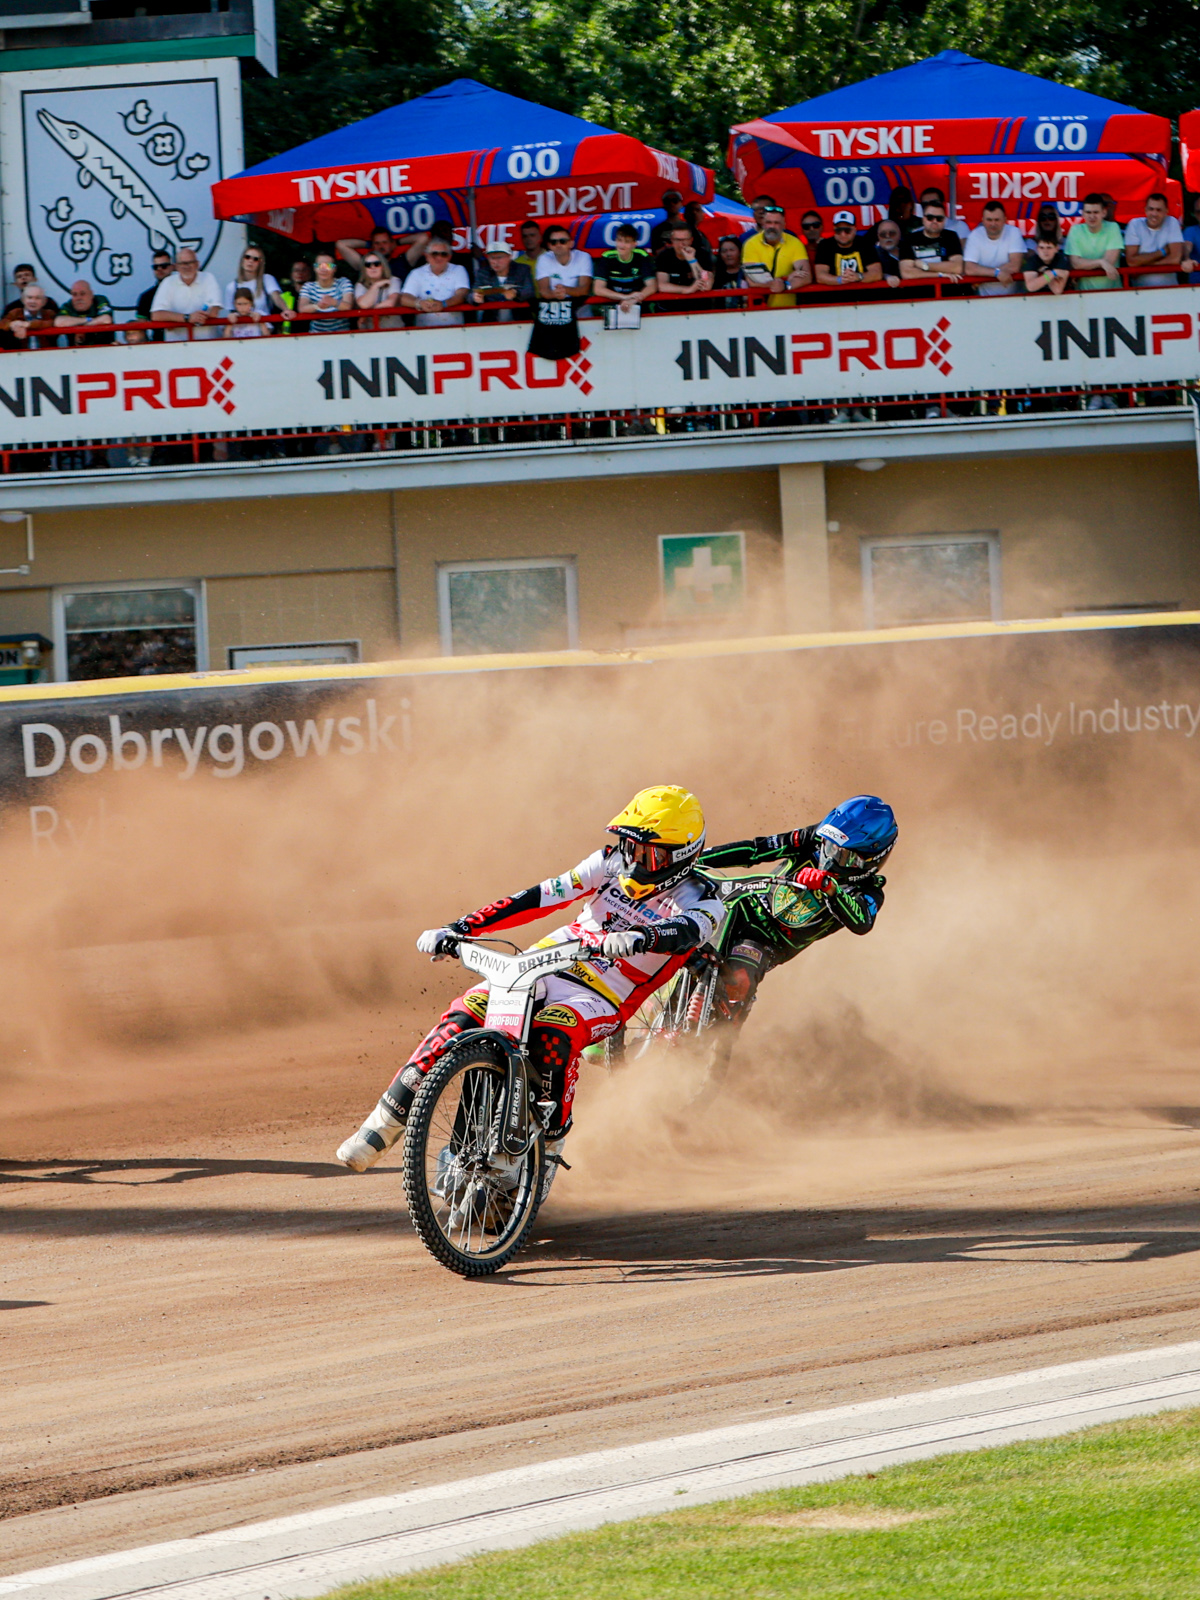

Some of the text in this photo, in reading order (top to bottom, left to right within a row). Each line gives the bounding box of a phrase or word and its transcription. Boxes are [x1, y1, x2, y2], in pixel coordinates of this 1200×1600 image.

[810, 125, 935, 158] TYSKIE
[1033, 122, 1088, 151] 0.0
[507, 148, 560, 180] 0.0
[291, 164, 412, 203] TYSKIE
[538, 301, 573, 319] 295
[675, 327, 930, 380] INNPRO
[1034, 313, 1200, 361] INNP
[21, 698, 412, 780] Dobrygowski
[956, 703, 1062, 746] Ready
[1069, 699, 1200, 738] Industry
[617, 826, 643, 842] TEXOM
[655, 857, 699, 892] TEXOM
[469, 950, 511, 974] RYNNY
[518, 950, 562, 973] BRYZA
[488, 1016, 520, 1027] PROFBUD
[537, 1008, 573, 1024] SZIK
[541, 1070, 553, 1104] TEX
